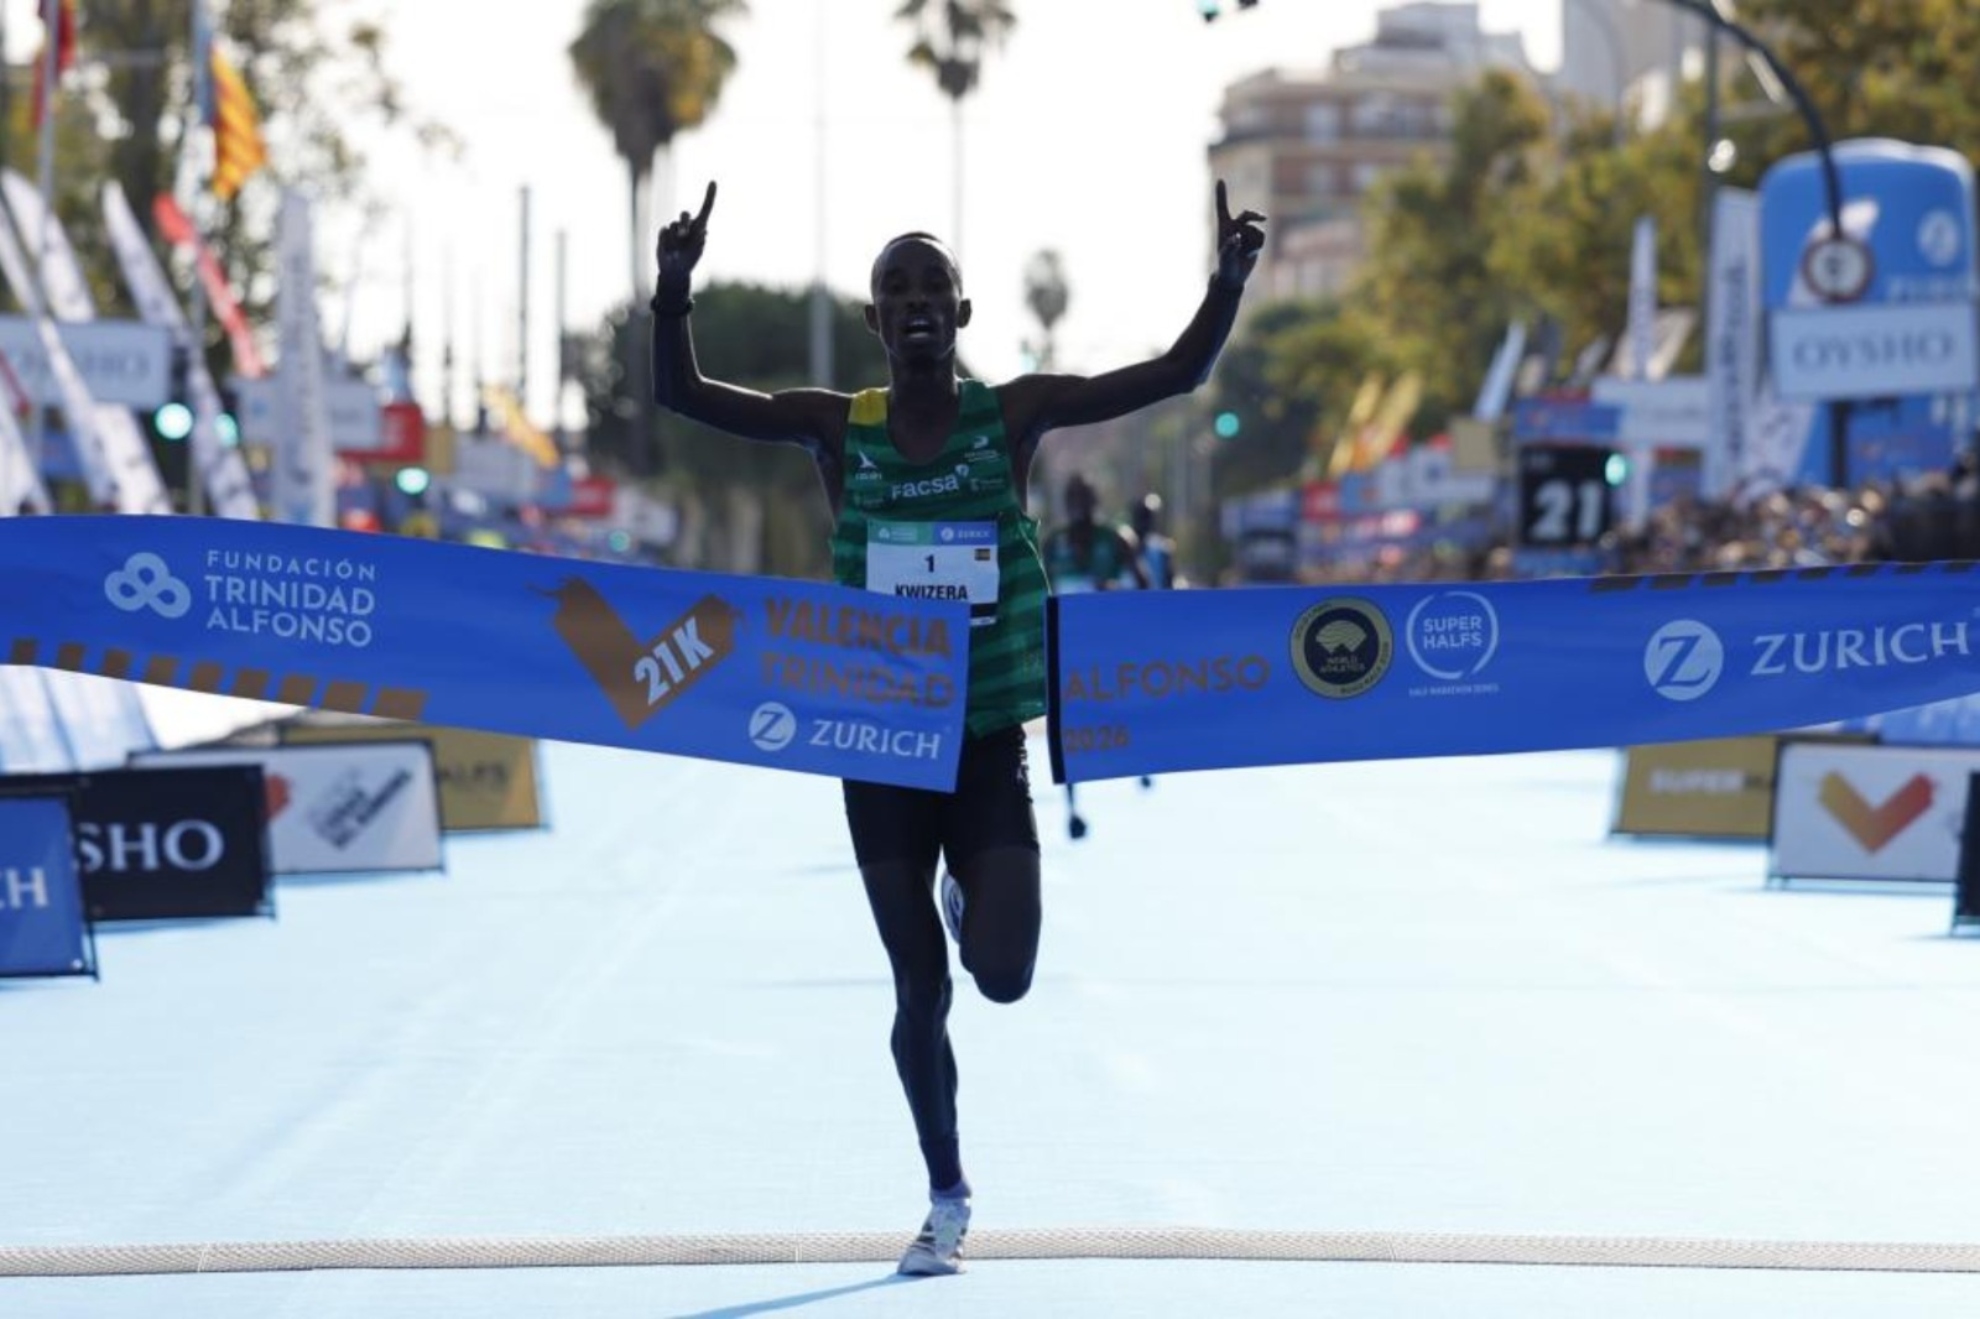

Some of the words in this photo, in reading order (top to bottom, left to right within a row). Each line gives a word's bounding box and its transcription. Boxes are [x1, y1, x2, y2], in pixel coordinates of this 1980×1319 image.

[1792, 331, 1954, 374] OYSHO
[1532, 480, 1603, 541] 21
[207, 549, 377, 582] FUNDACIÓN
[924, 553, 936, 574] 1
[205, 575, 376, 616] TRINIDAD
[894, 583, 969, 601] KWIZERA
[206, 607, 373, 648] ALFONSO
[763, 597, 954, 660] VALENCIA
[1422, 615, 1483, 634] SUPER
[1422, 631, 1483, 650] HALFS
[1750, 621, 1971, 676] ZURICH
[760, 652, 955, 710] TRINIDAD
[1065, 653, 1271, 701] ALFONSO
[809, 719, 942, 760] ZURICH
